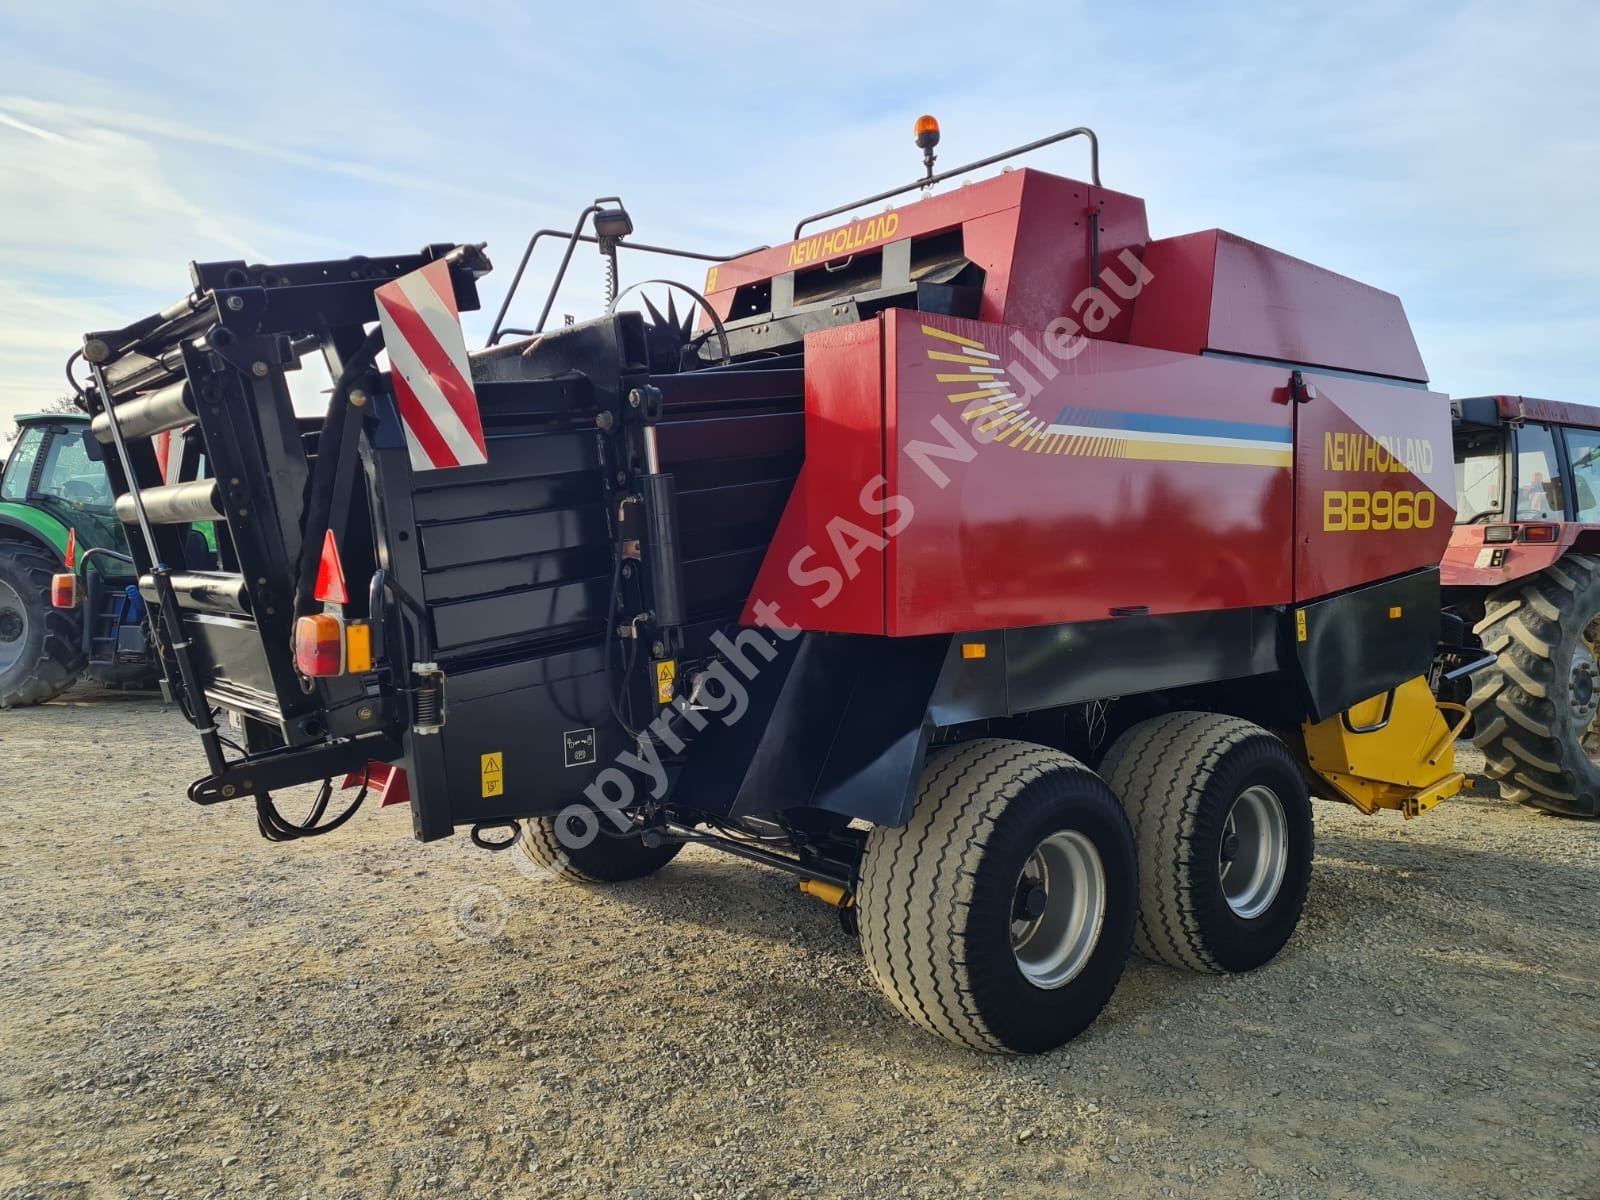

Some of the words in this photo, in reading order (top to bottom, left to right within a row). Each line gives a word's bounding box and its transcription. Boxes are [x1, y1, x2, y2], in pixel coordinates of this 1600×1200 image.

[788, 237, 822, 267] NEW
[822, 213, 899, 257] HOLLAND
[1324, 431, 1363, 472] NEW
[1363, 434, 1433, 474] HOLLAND
[1323, 490, 1436, 532] BB960
